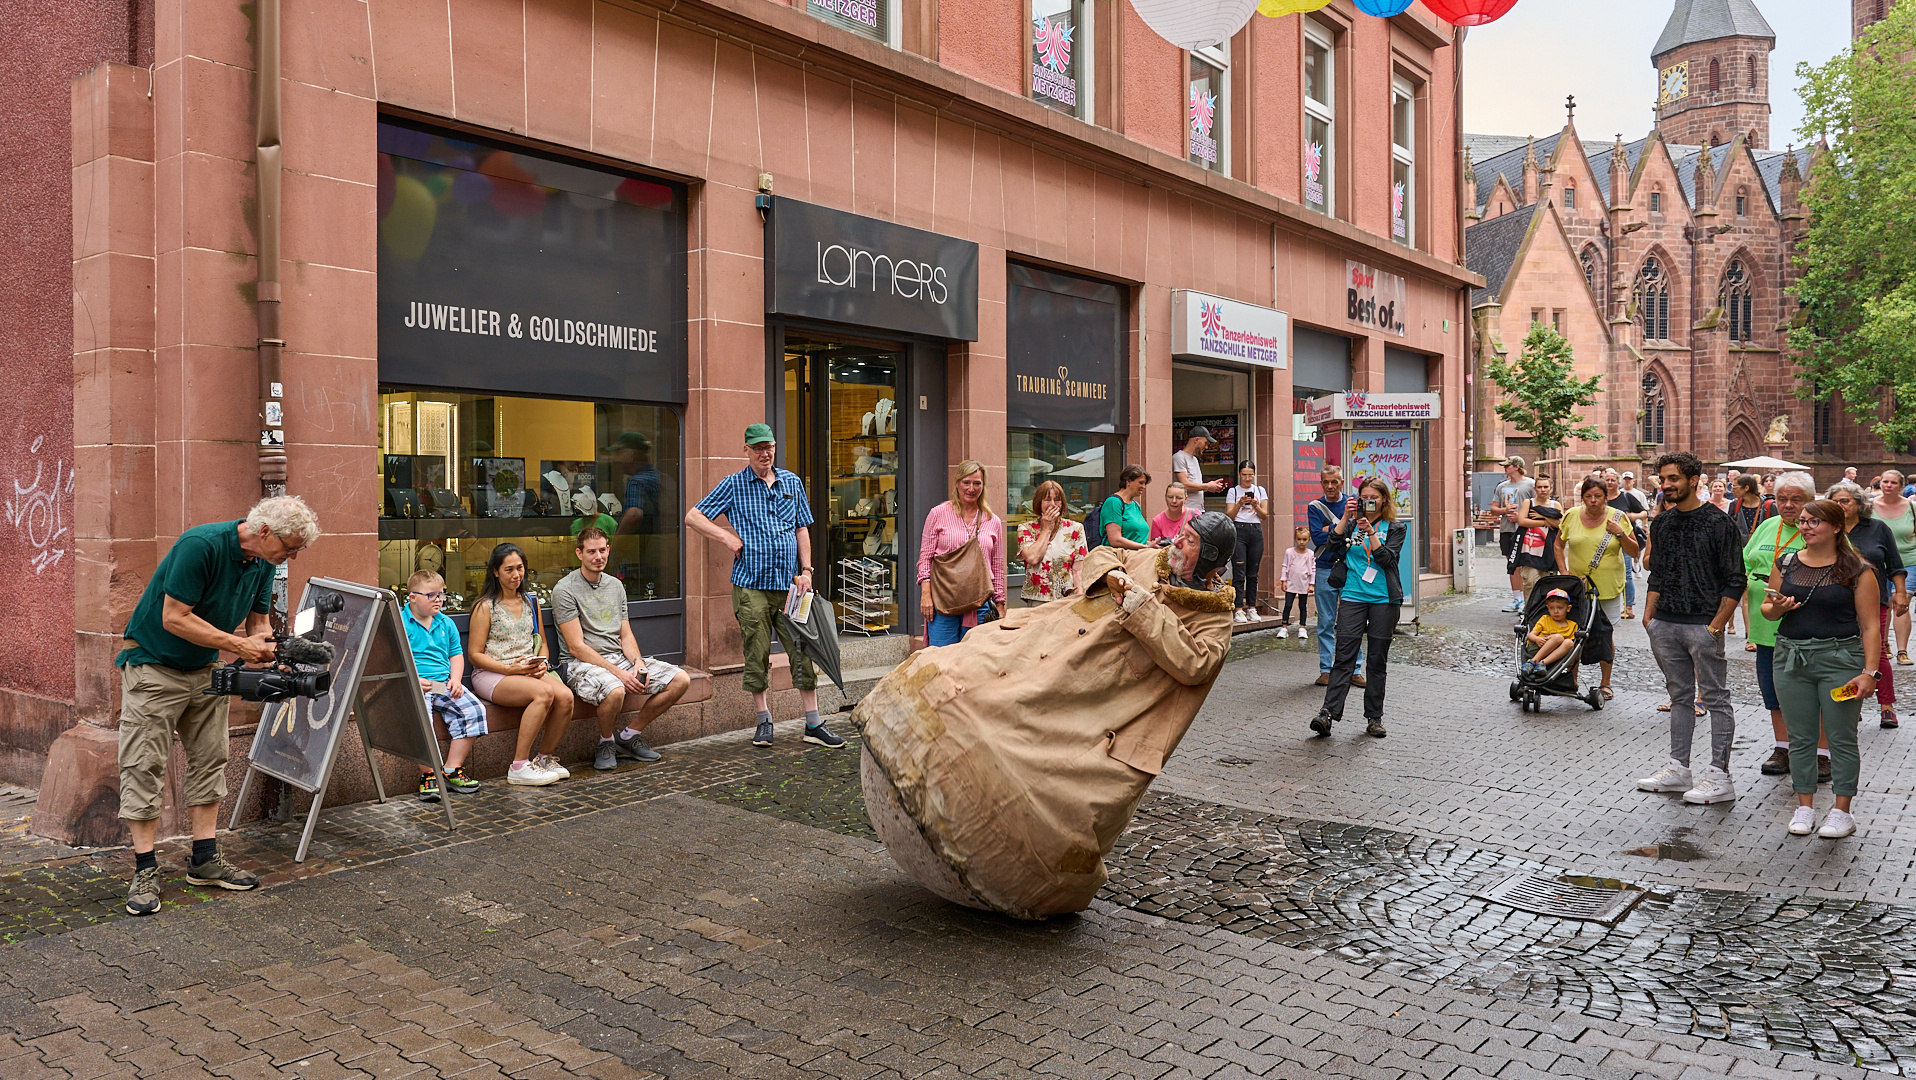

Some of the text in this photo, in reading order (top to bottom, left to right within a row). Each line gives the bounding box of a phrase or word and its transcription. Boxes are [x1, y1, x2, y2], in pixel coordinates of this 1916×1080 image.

[1190, 140, 1218, 163] ETZGER
[1352, 267, 1375, 289] Sport
[1347, 287, 1376, 326] Best
[404, 301, 658, 353] JUWELIER & GOLDSCHMIEDE
[1220, 325, 1278, 350] Tanzerlebniswelt
[1200, 337, 1278, 363] TANZSCHULE METZGER
[1016, 374, 1107, 400] TRAURING SCHMIEDE
[1345, 410, 1394, 418] TANZSCHULE
[1366, 402, 1431, 410] Tanzerlebniswelt
[1355, 437, 1409, 451] Jetzt TANZT
[1353, 453, 1410, 464] der SOMMER
